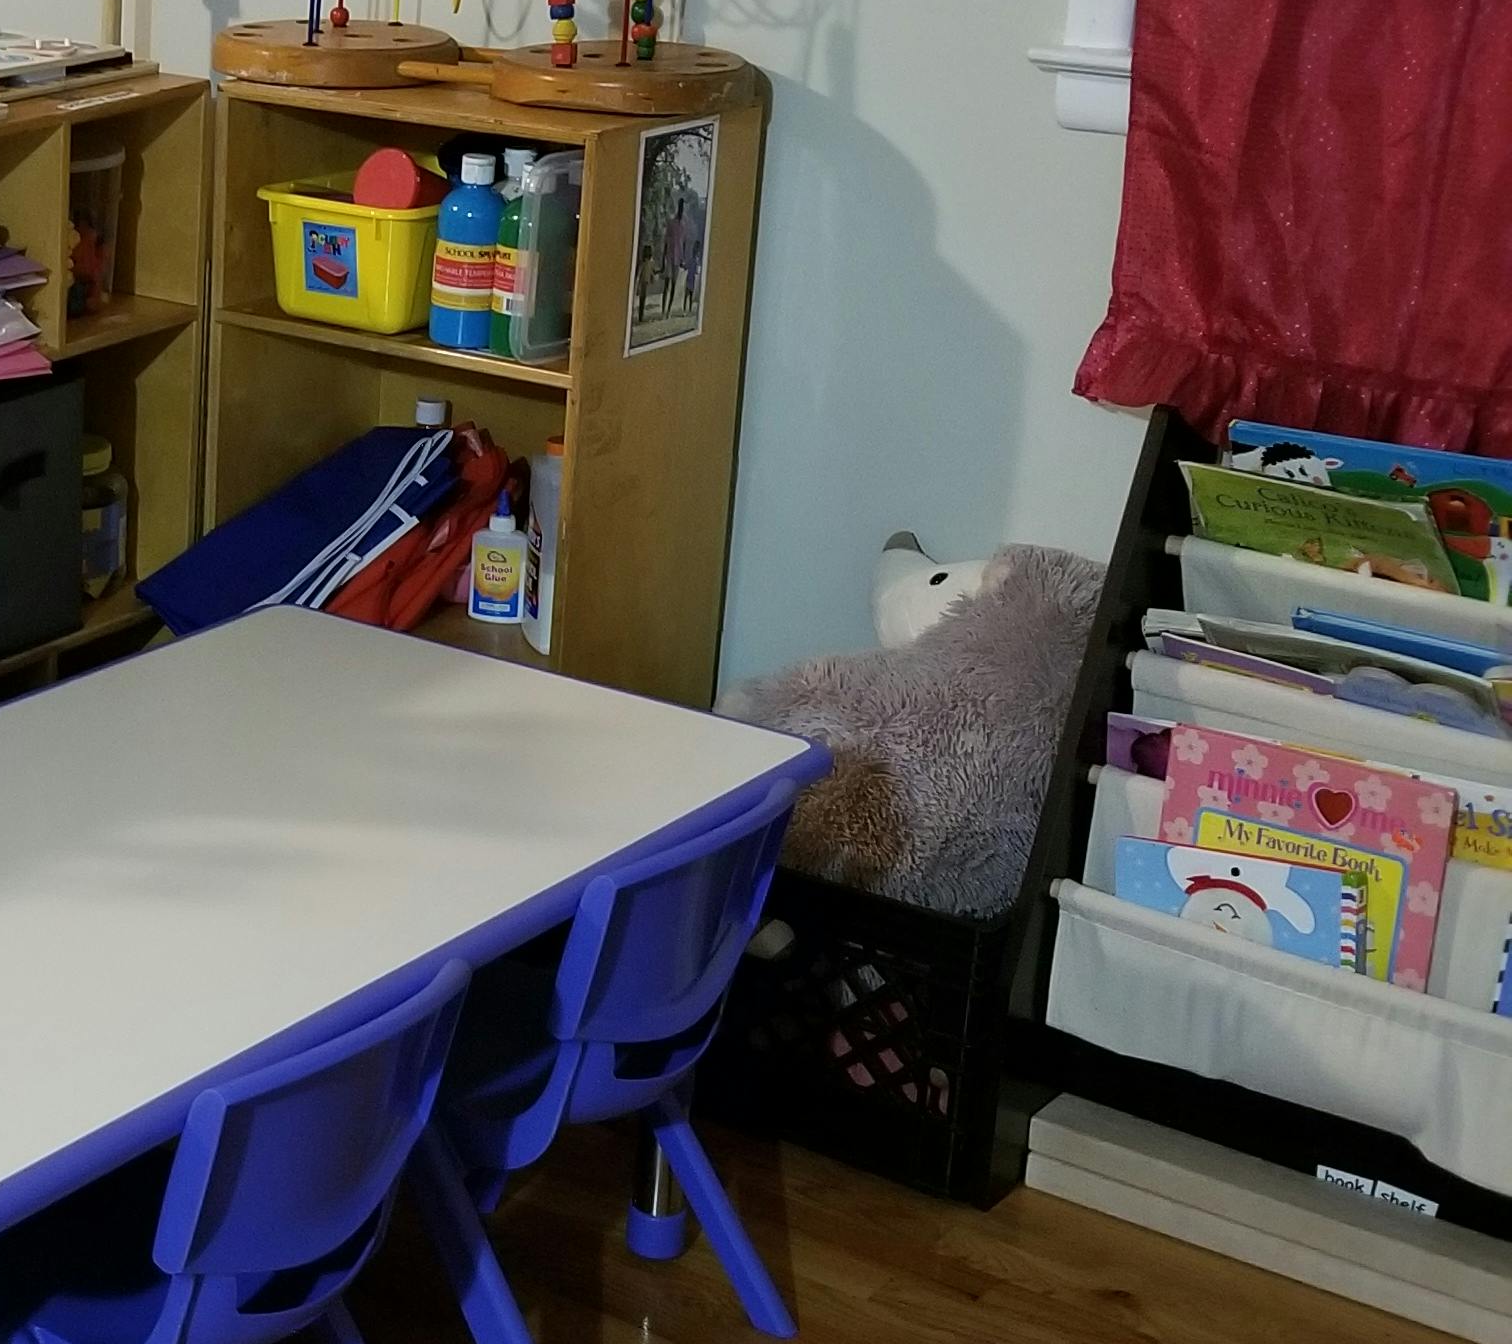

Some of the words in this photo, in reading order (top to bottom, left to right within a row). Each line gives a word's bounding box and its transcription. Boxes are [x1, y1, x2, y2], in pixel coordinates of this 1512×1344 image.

[1215, 493, 1316, 522] Curious
[480, 563, 514, 574] School
[484, 573, 507, 583] Glue
[1217, 818, 1253, 845] My
[1255, 827, 1329, 862] Favorite
[1332, 846, 1384, 883] Book
[1324, 1168, 1366, 1194] book
